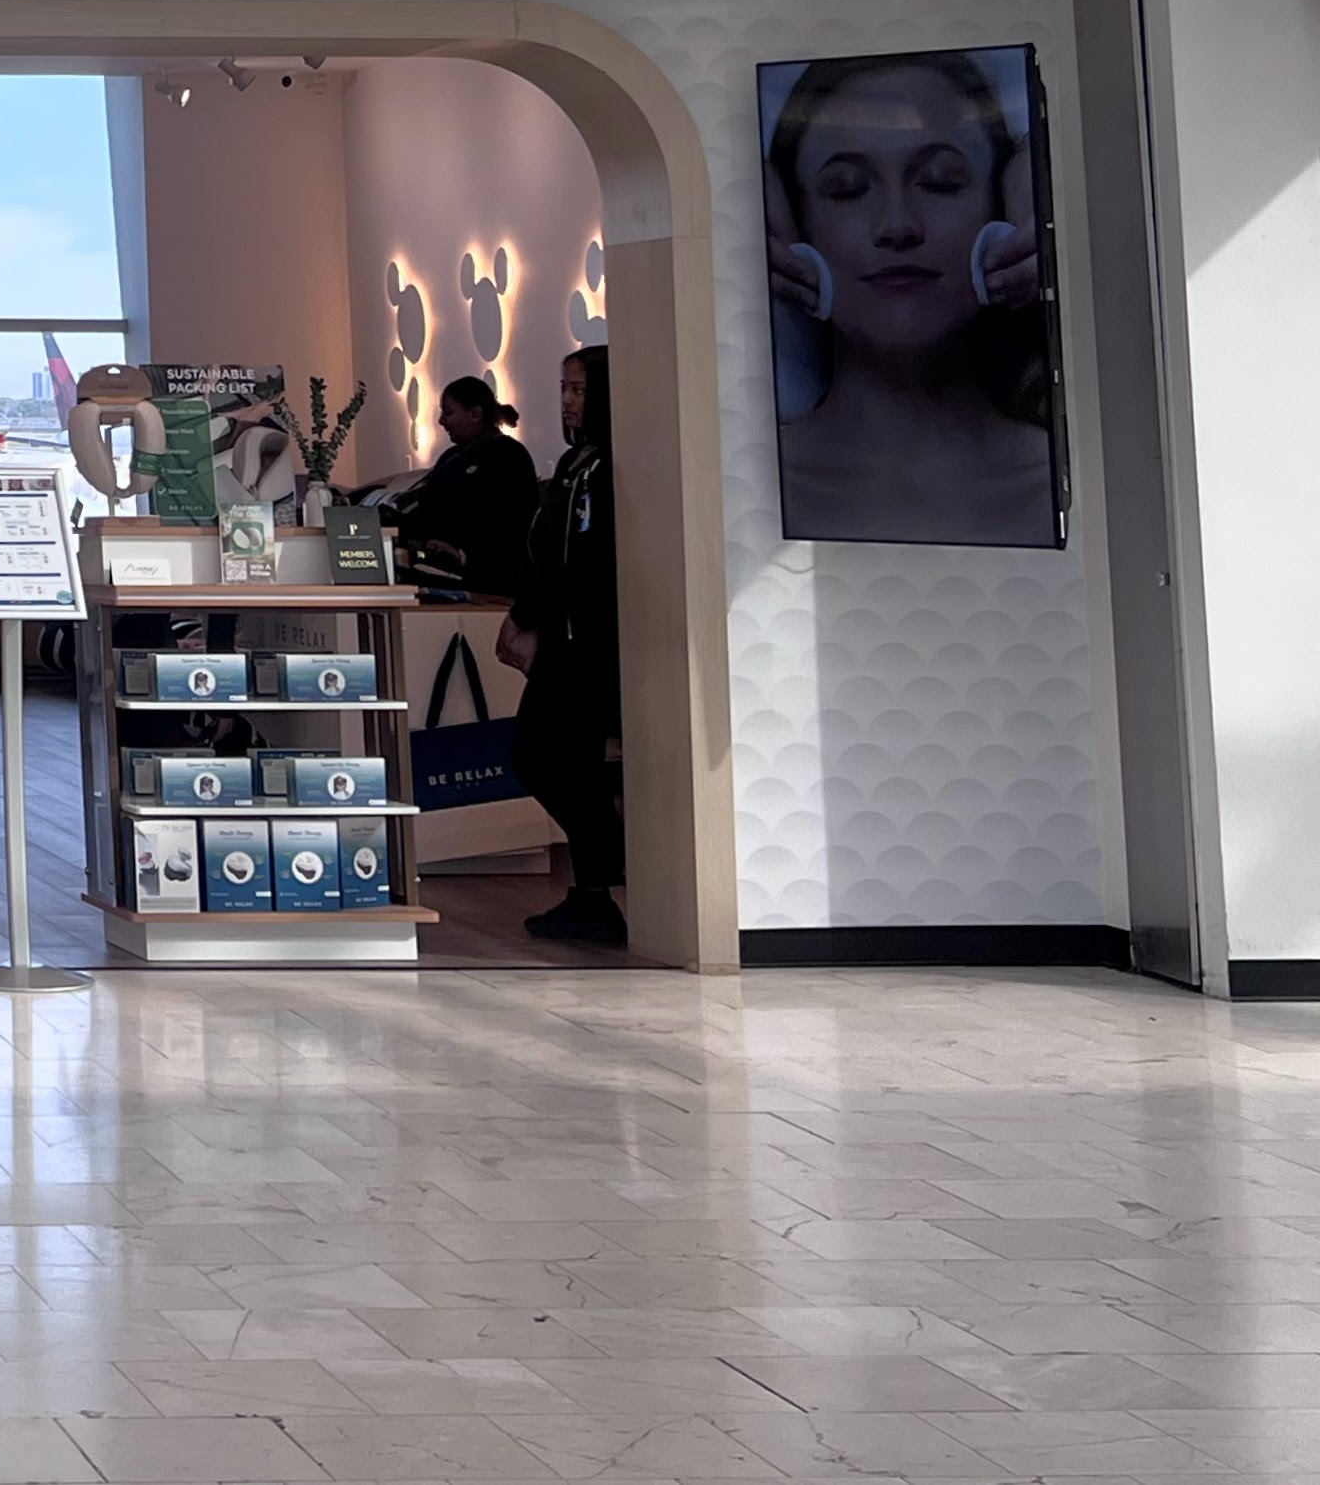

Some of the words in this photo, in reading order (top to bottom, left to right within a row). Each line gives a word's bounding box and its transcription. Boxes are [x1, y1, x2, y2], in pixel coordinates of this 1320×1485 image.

[166, 368, 255, 380] SUSTAINABLE
[168, 383, 227, 394] PACKING
[229, 383, 256, 394] LIST
[428, 774, 447, 786] BE
[455, 765, 503, 782] RELAX
